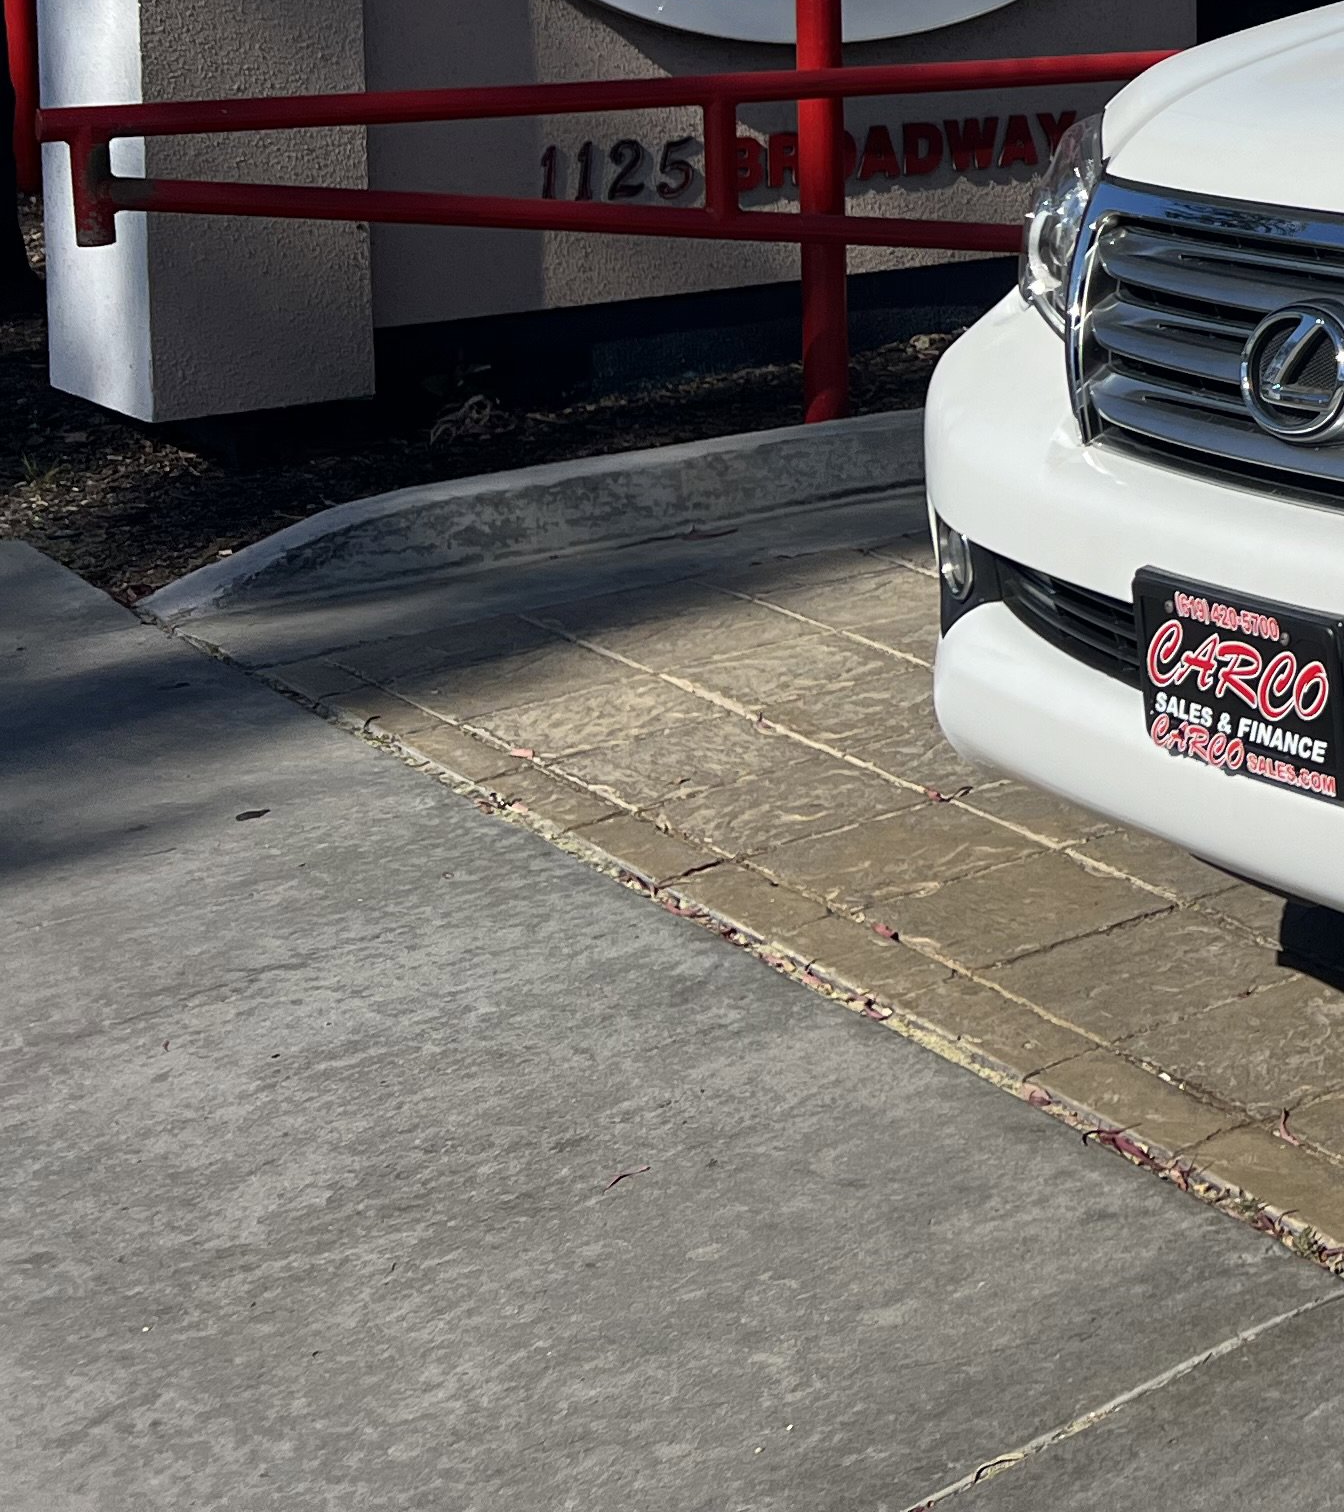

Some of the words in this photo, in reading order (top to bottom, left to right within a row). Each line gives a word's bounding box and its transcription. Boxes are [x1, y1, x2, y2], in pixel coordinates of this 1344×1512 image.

[541, 137, 699, 201] 1125
[1147, 619, 1329, 721] CARCO
[1155, 691, 1213, 728] SALES
[1217, 712, 1232, 735] &
[1237, 717, 1328, 763] FINANCE
